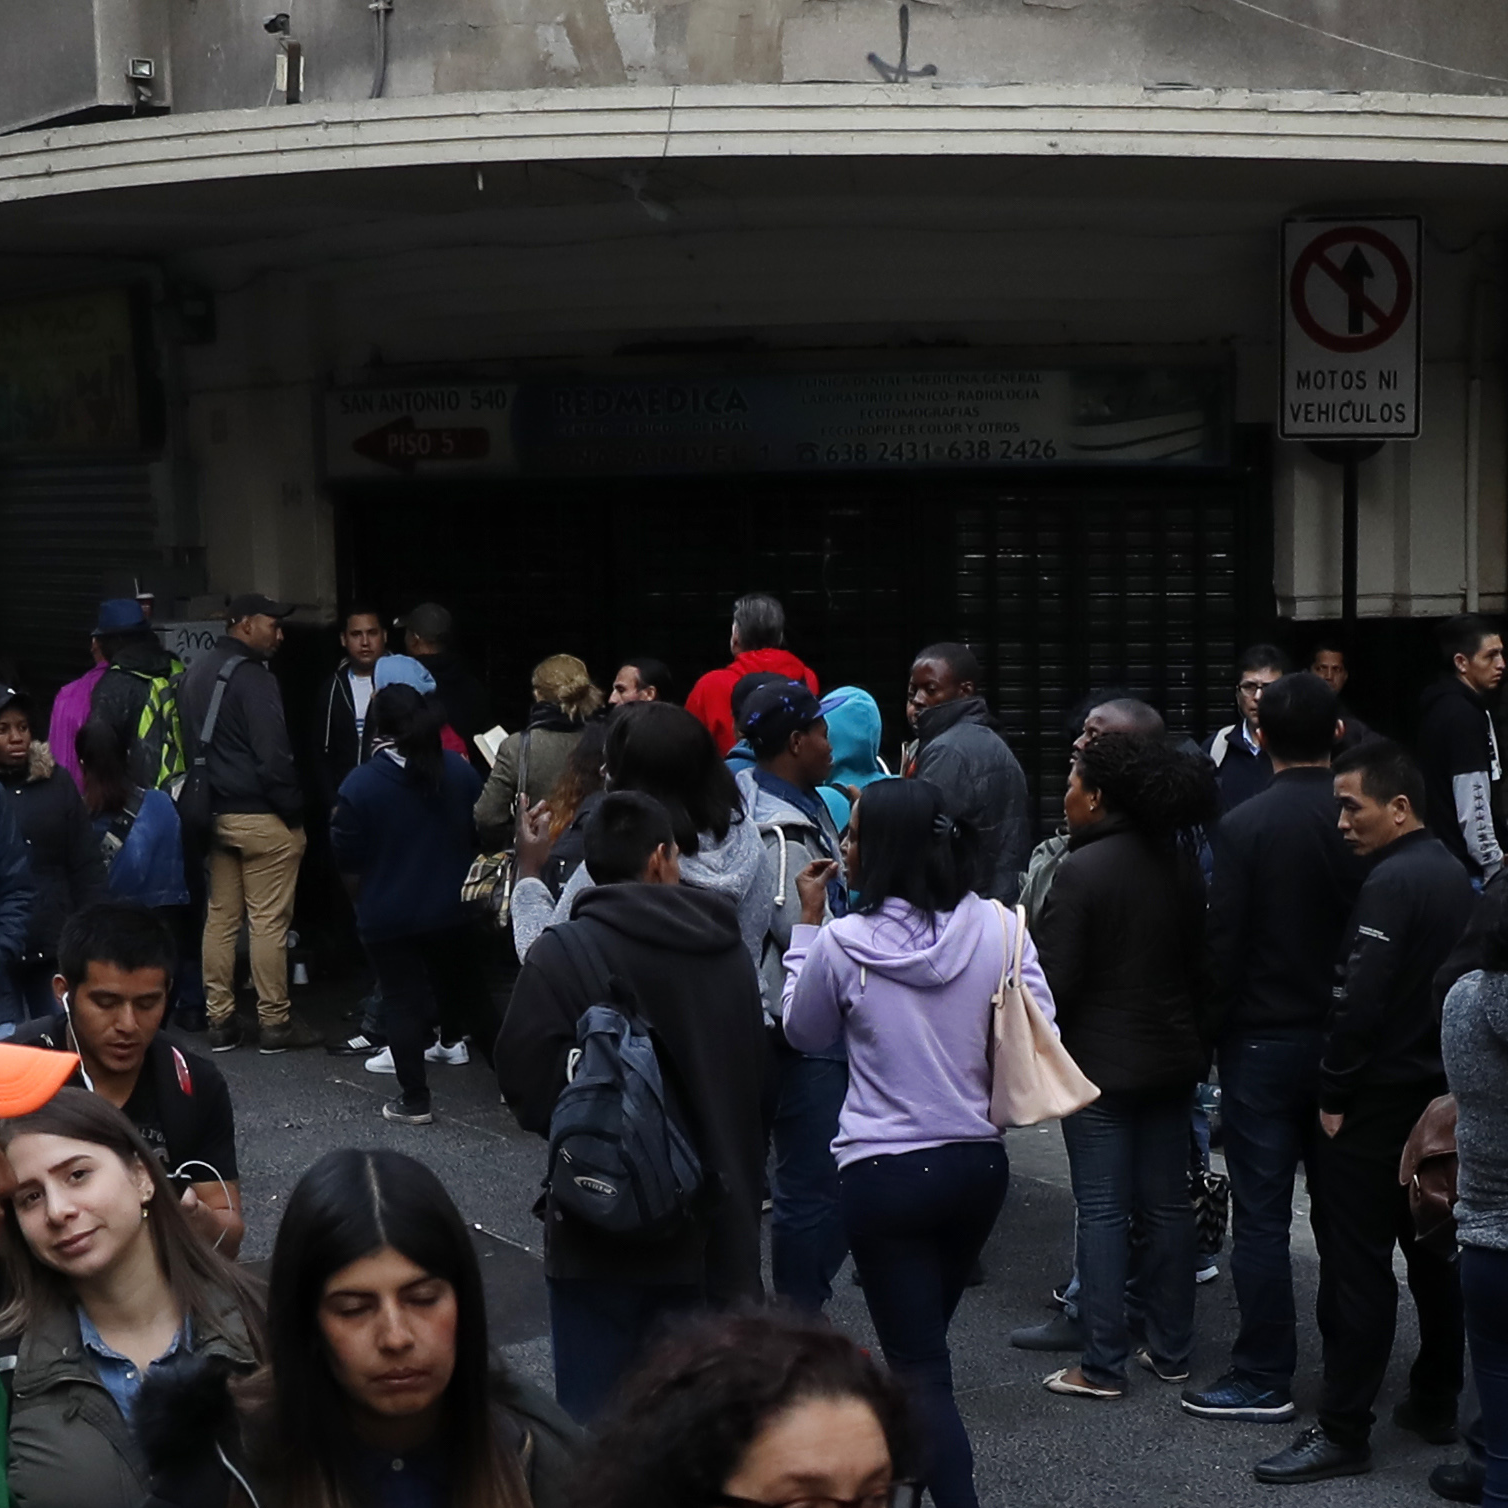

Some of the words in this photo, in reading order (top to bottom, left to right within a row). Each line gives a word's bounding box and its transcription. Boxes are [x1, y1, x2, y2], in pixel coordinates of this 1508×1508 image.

[983, 371, 1042, 384] GENERAL
[1296, 370, 1367, 391] MOTOS
[1379, 370, 1398, 390] NI
[340, 394, 374, 415] SAN
[379, 391, 460, 412] ANTONIO
[470, 388, 507, 411] 540
[553, 385, 749, 416] REDMEDICA
[802, 391, 893, 405] LABORATORIO
[693, 420, 749, 434] DENTAL
[919, 423, 963, 435] COLOR
[965, 423, 974, 434] Y
[978, 422, 1020, 434] OTROS
[387, 432, 431, 456] PISO
[826, 442, 868, 463] 638
[877, 441, 930, 463] 2431
[947, 440, 991, 461] 638
[999, 438, 1057, 460] 2426
[656, 444, 747, 466] NIVEL
